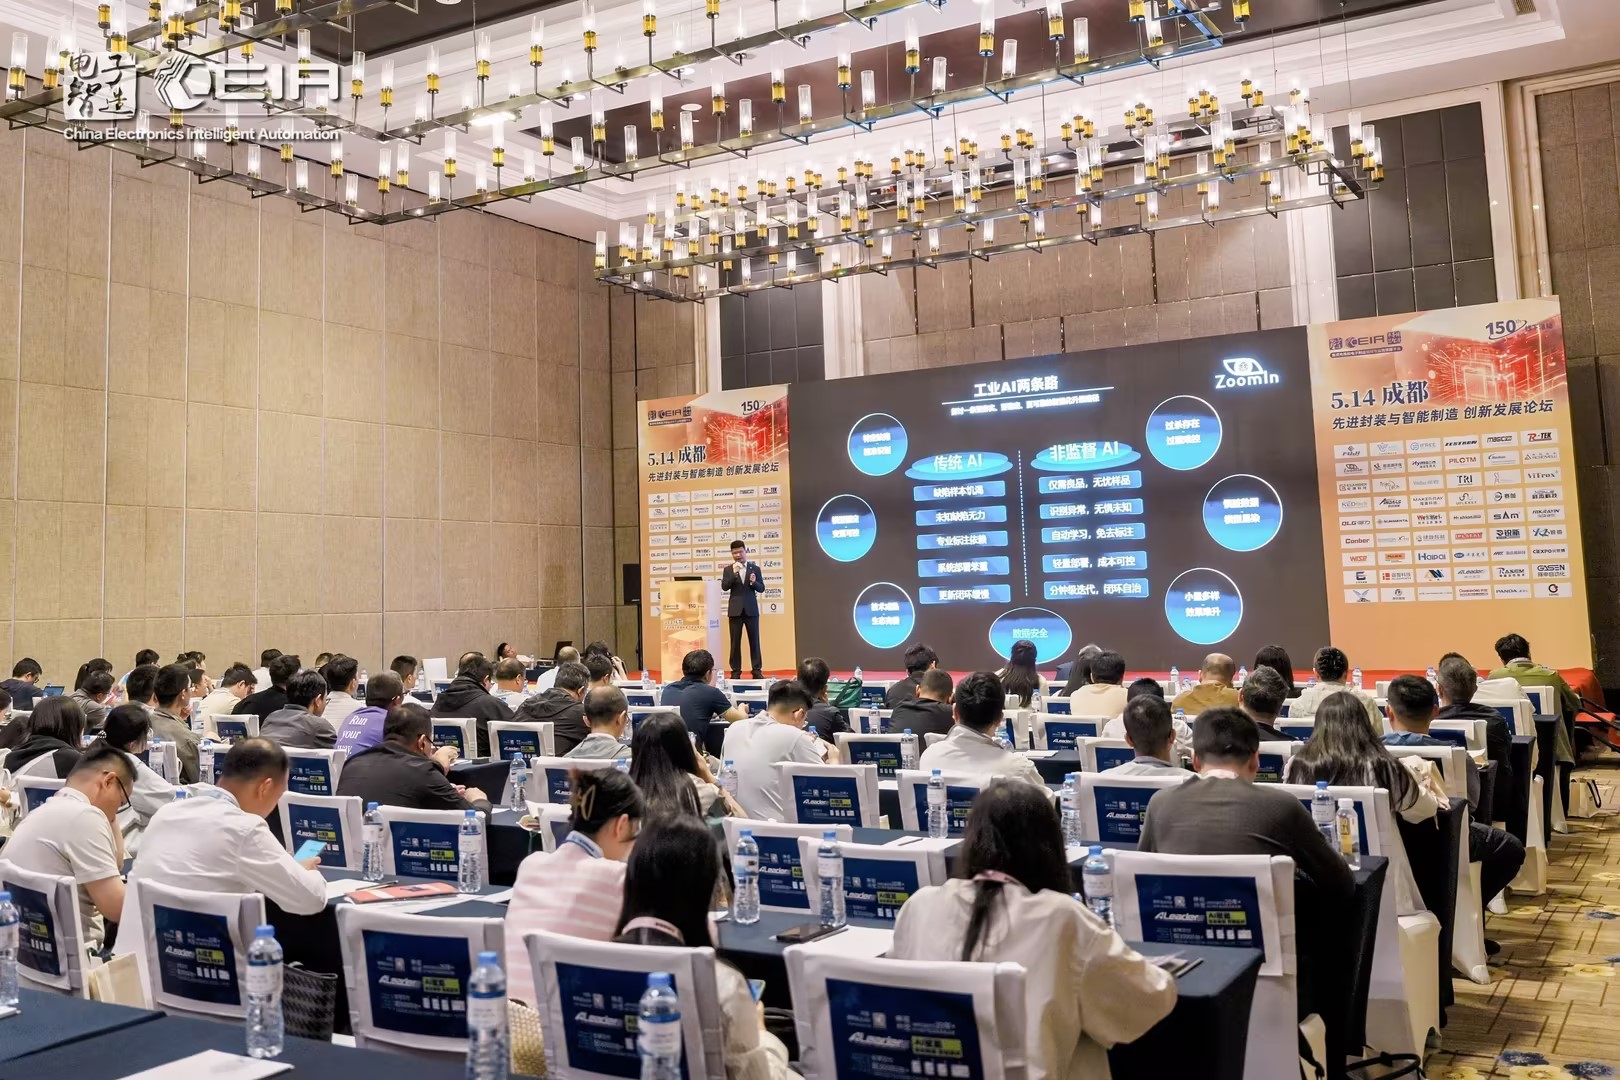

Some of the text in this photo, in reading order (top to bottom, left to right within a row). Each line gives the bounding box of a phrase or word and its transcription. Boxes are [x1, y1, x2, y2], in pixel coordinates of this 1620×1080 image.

[974, 375, 1059, 398] 工业AI两条路
[1215, 371, 1280, 389] ZoomIn
[1331, 380, 1429, 410] 5.14 成都
[1332, 399, 1554, 430] 先进封装与智能制造 创新发展论坛
[648, 445, 706, 466] 5.14 成都
[1049, 440, 1118, 461] 非监督 AI
[648, 462, 779, 483] 先进封装与智能制造 创新发展论坛
[933, 453, 982, 472] 传统 AI
[1012, 627, 1049, 640] 数据安全
[349, 715, 368, 725] Run
[340, 730, 361, 741] your
[1154, 911, 1199, 921] ALeader
